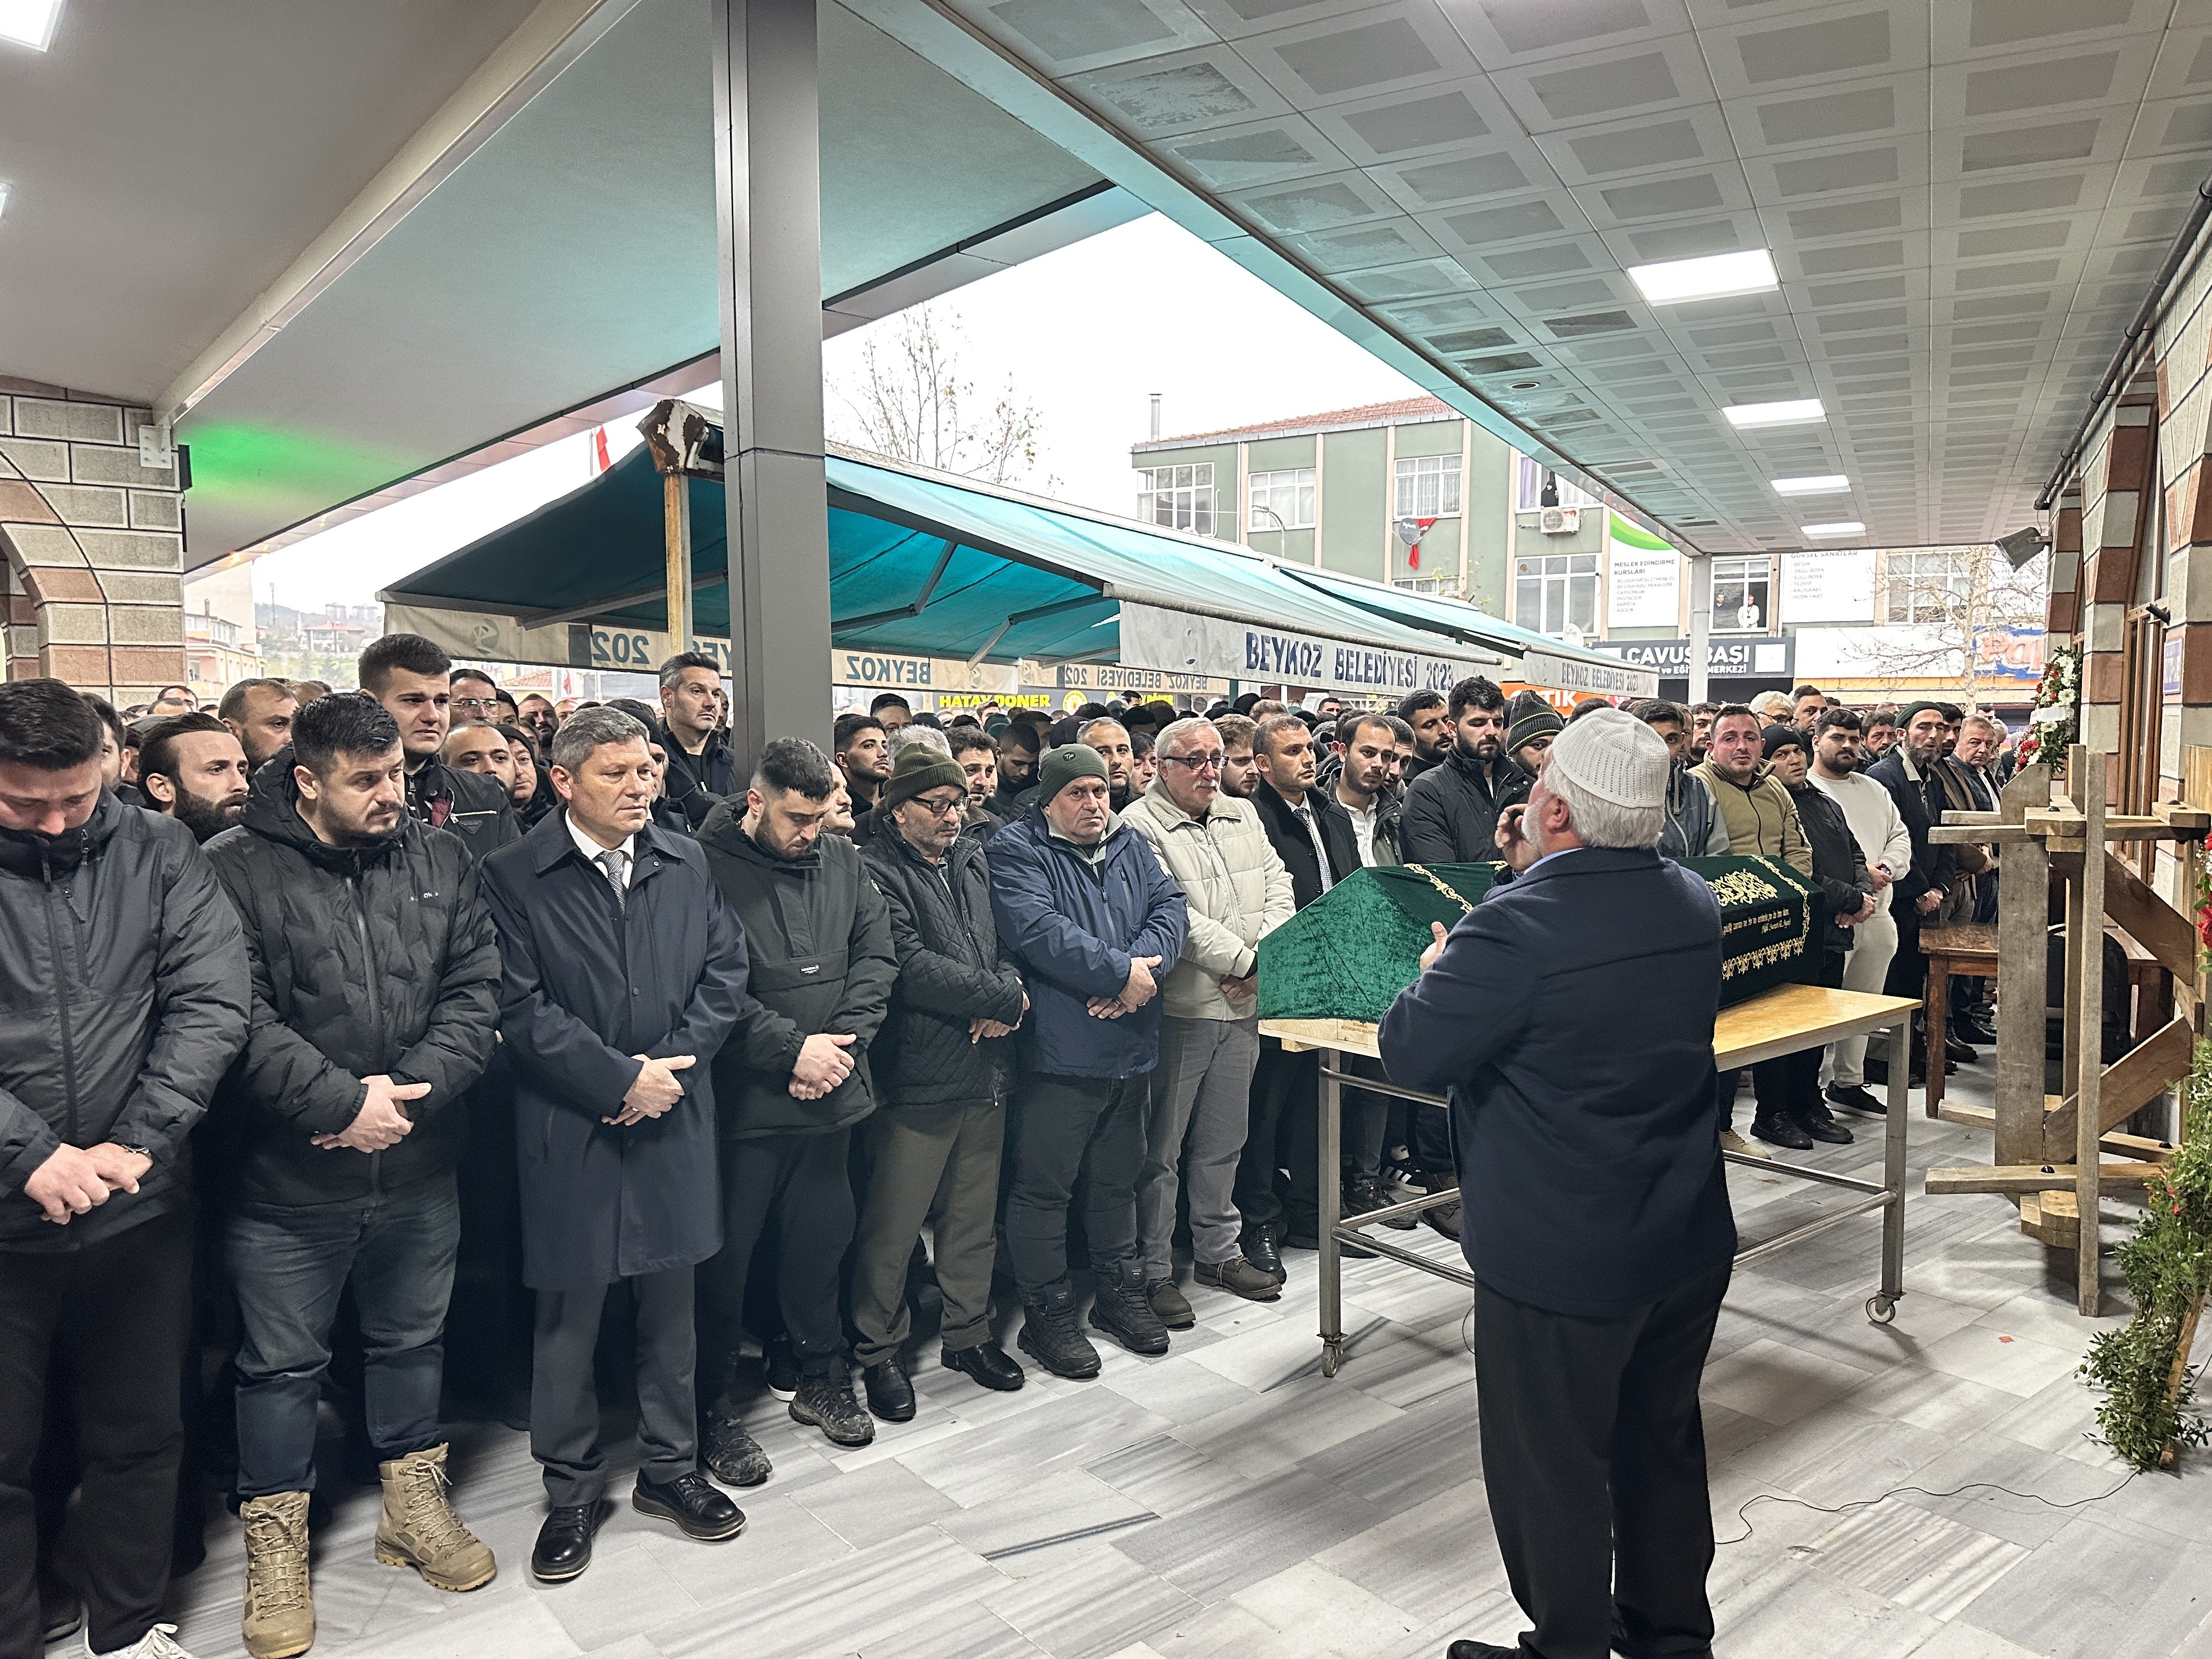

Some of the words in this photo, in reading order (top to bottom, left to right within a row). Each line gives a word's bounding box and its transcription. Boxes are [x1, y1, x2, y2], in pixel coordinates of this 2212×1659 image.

[1245, 631, 1323, 678] BEYKOZ
[1334, 647, 1418, 688] BELEDİYESİ
[1426, 662, 1453, 691] 2023
[1707, 664, 1747, 674] MERKEZİ
[1562, 662, 1588, 686] BEYKOZ
[1592, 668, 1624, 691] BELEDİYESİ
[1626, 673, 1639, 692] 2023
[939, 694, 992, 708] HATAY
